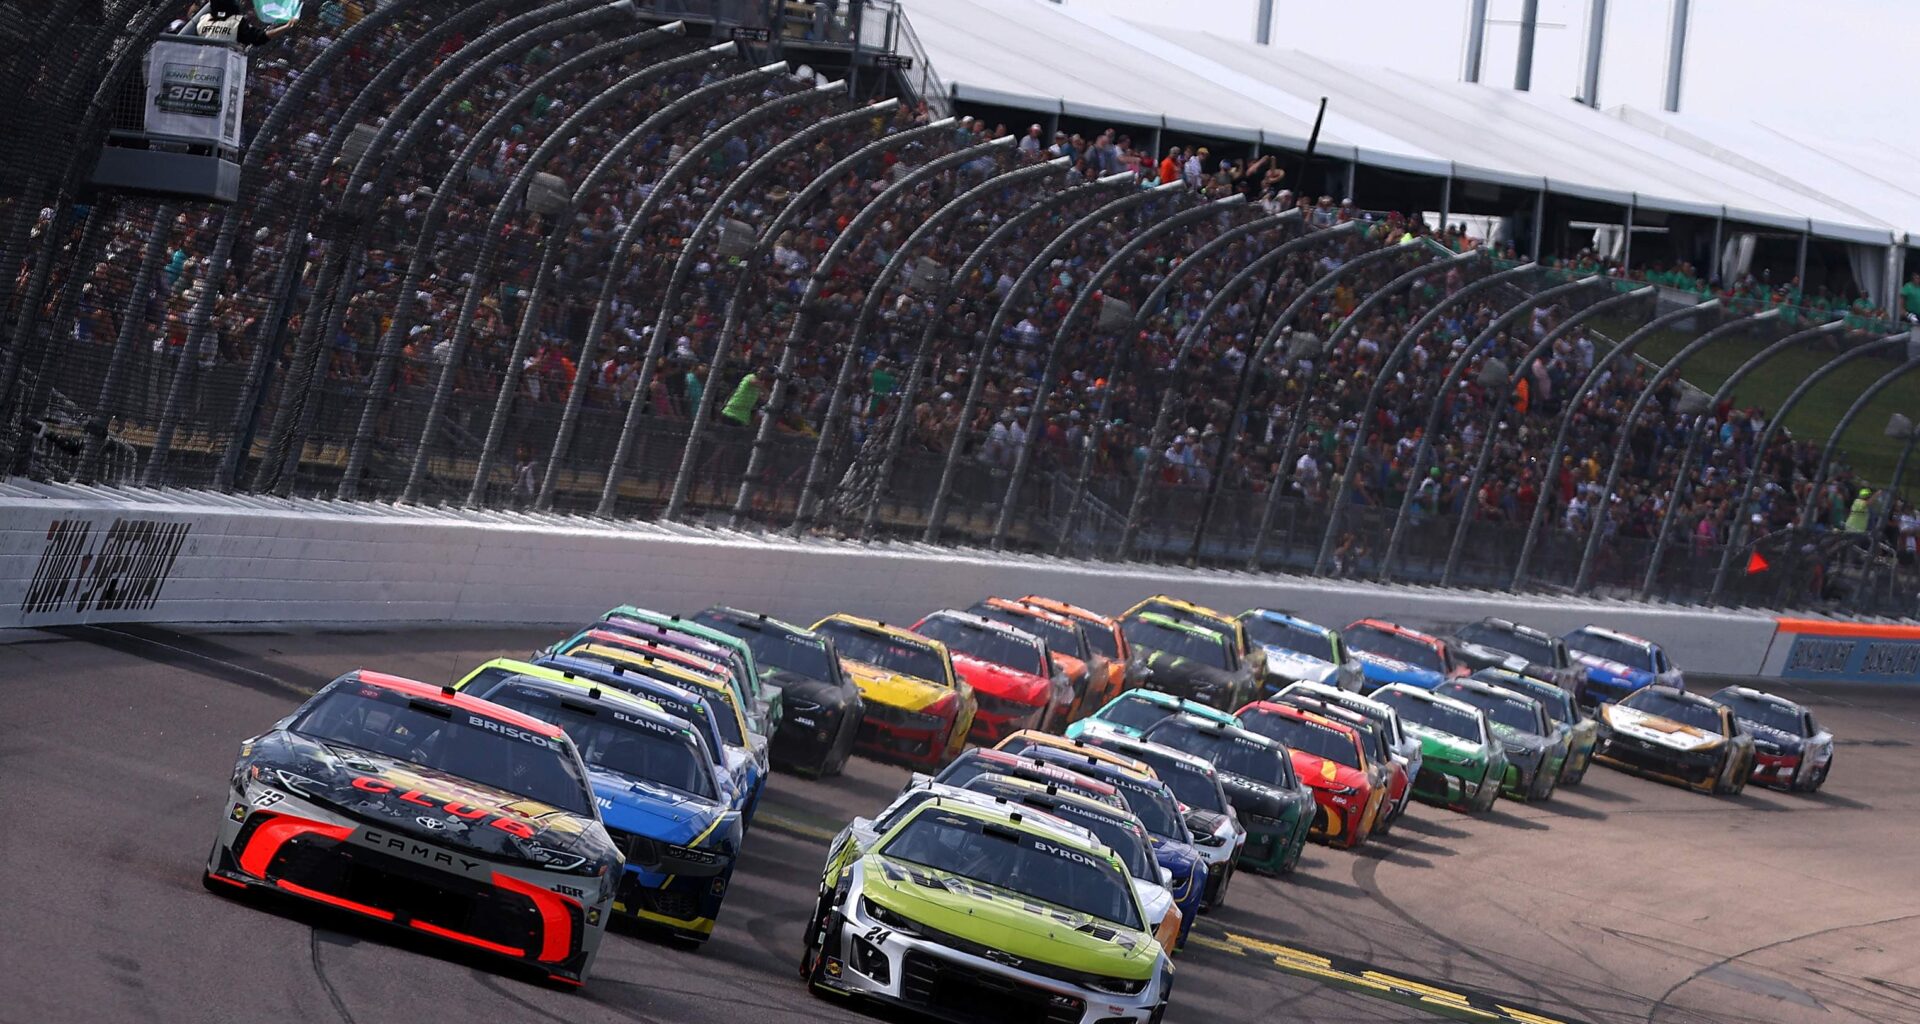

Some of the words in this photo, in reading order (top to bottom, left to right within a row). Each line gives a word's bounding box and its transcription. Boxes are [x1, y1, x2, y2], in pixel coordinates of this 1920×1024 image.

[201, 25, 232, 36] OFFICIAL
[194, 72, 220, 83] CORN
[168, 86, 214, 102] 350
[76, 517, 192, 613] SPEEDWAY
[626, 687, 688, 713] LARSON
[468, 715, 563, 751] BRISCOE
[613, 711, 679, 737] BLANEY
[1305, 720, 1346, 737] REDDICK
[1105, 776, 1159, 798] ELLIOTT
[351, 776, 537, 839] CLUB
[364, 831, 480, 871] CAMRY
[1034, 841, 1097, 868] BYRON
[550, 884, 585, 900] JGR
[864, 926, 893, 946] 24
